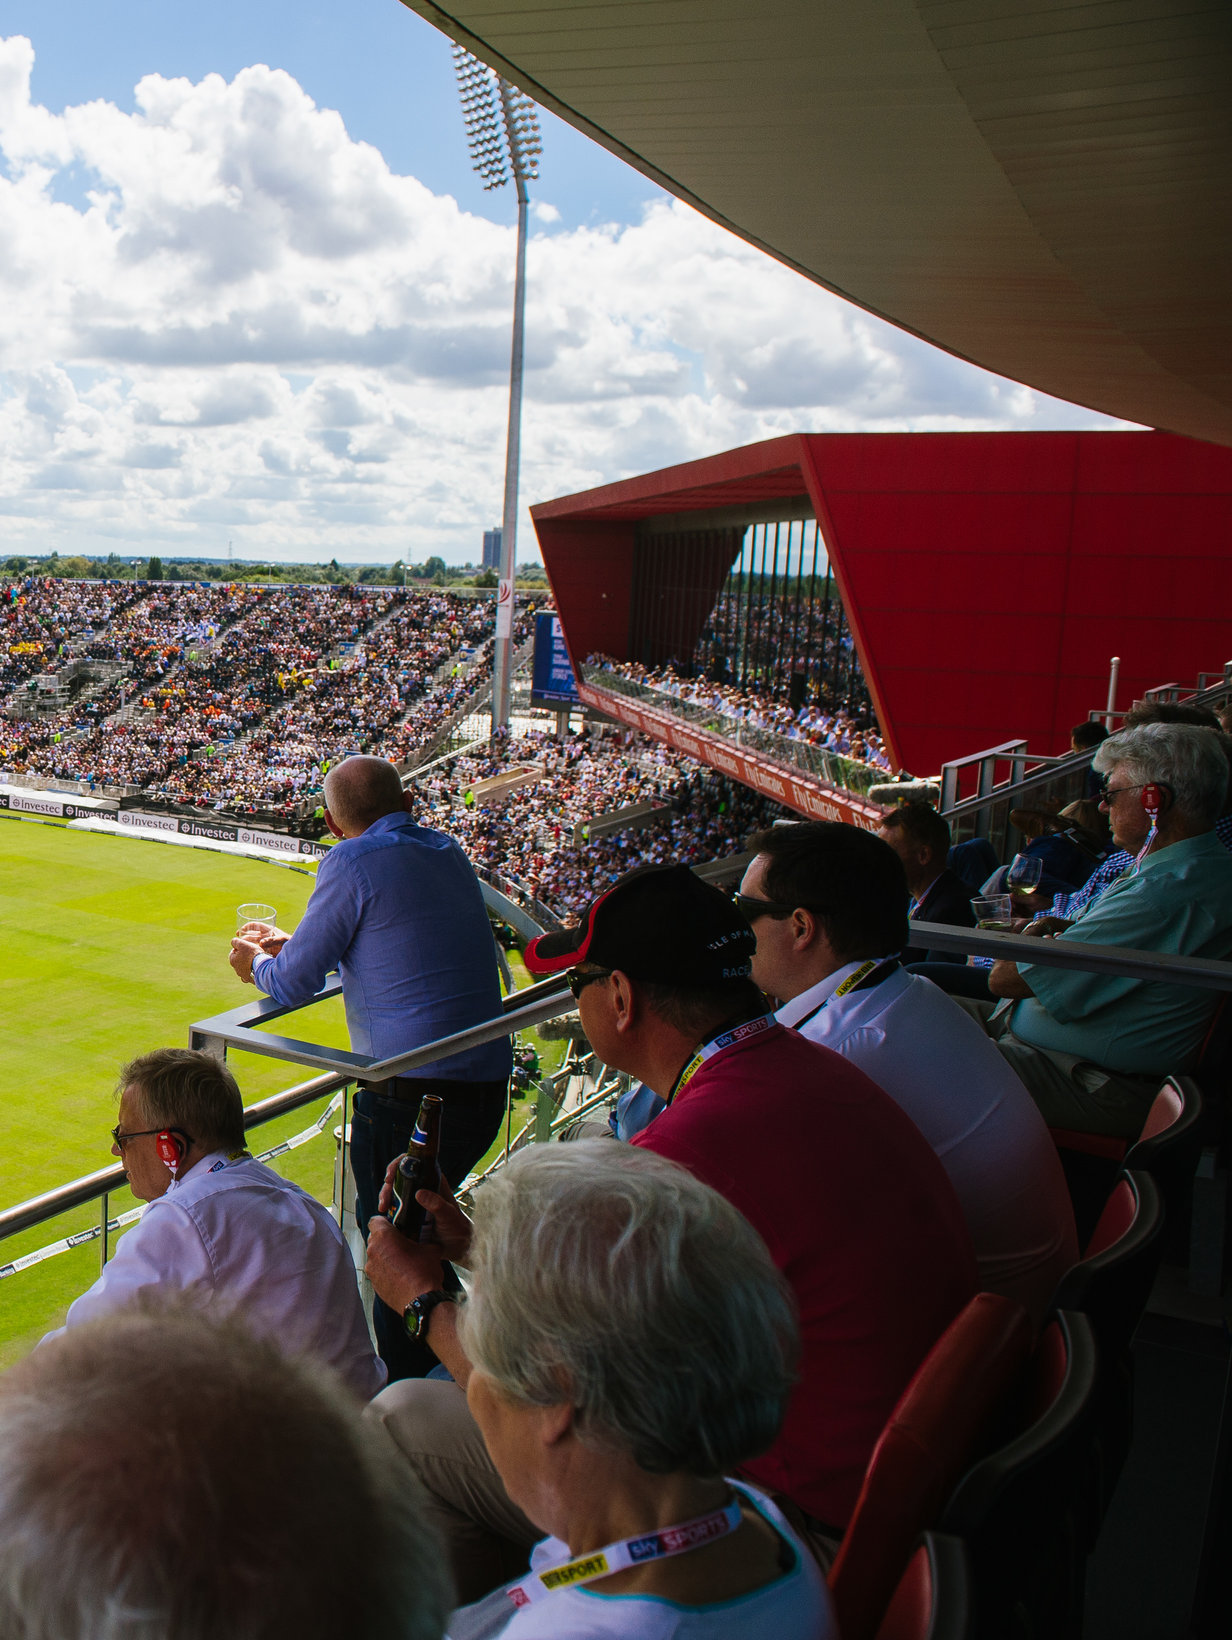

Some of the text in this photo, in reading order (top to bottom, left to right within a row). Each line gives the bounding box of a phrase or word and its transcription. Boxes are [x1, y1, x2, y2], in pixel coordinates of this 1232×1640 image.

[744, 762, 786, 797] Fly Emirates
[21, 798, 62, 814] Investec
[793, 784, 842, 822] Fly Emirates
[75, 806, 117, 821] Investec
[131, 814, 176, 832] Investec
[191, 820, 236, 842] Investec
[252, 833, 296, 852] Investec
[707, 936, 728, 950] ISLE
[734, 1020, 767, 1039] SPORTS
[682, 1056, 702, 1083] SPORT
[561, 1558, 605, 1580] SPORT
[631, 1540, 659, 1558] sky
[663, 1516, 729, 1550] SPORTS
